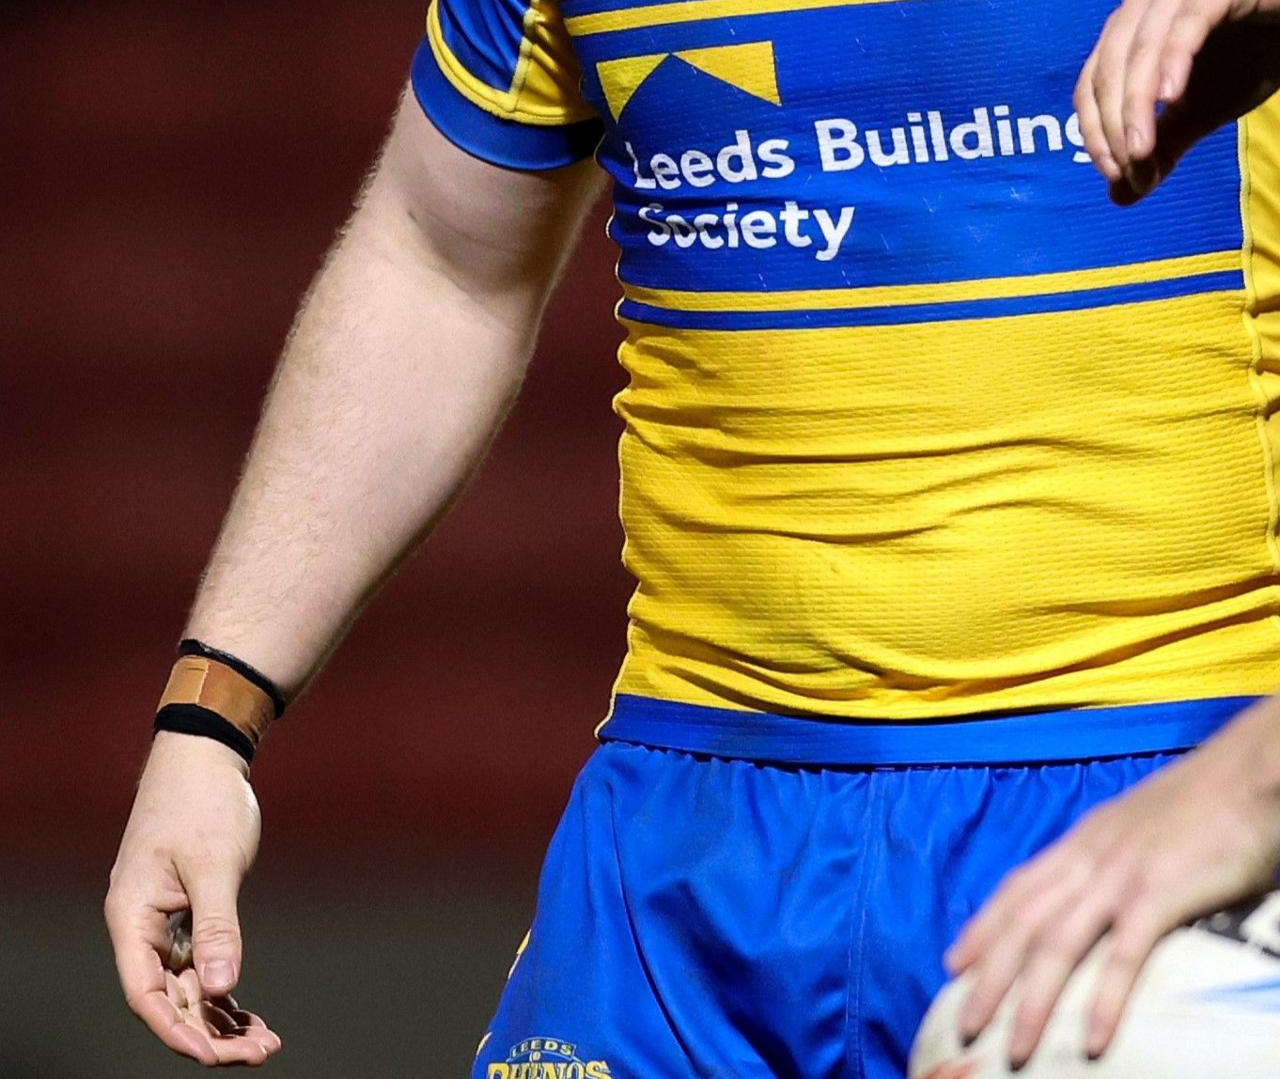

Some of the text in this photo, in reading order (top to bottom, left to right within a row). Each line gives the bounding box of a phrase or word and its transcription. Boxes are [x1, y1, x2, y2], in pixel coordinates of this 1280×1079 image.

[625, 130, 796, 191] Leeds
[638, 201, 855, 262] Society
[511, 1040, 572, 1058] LEEDS
